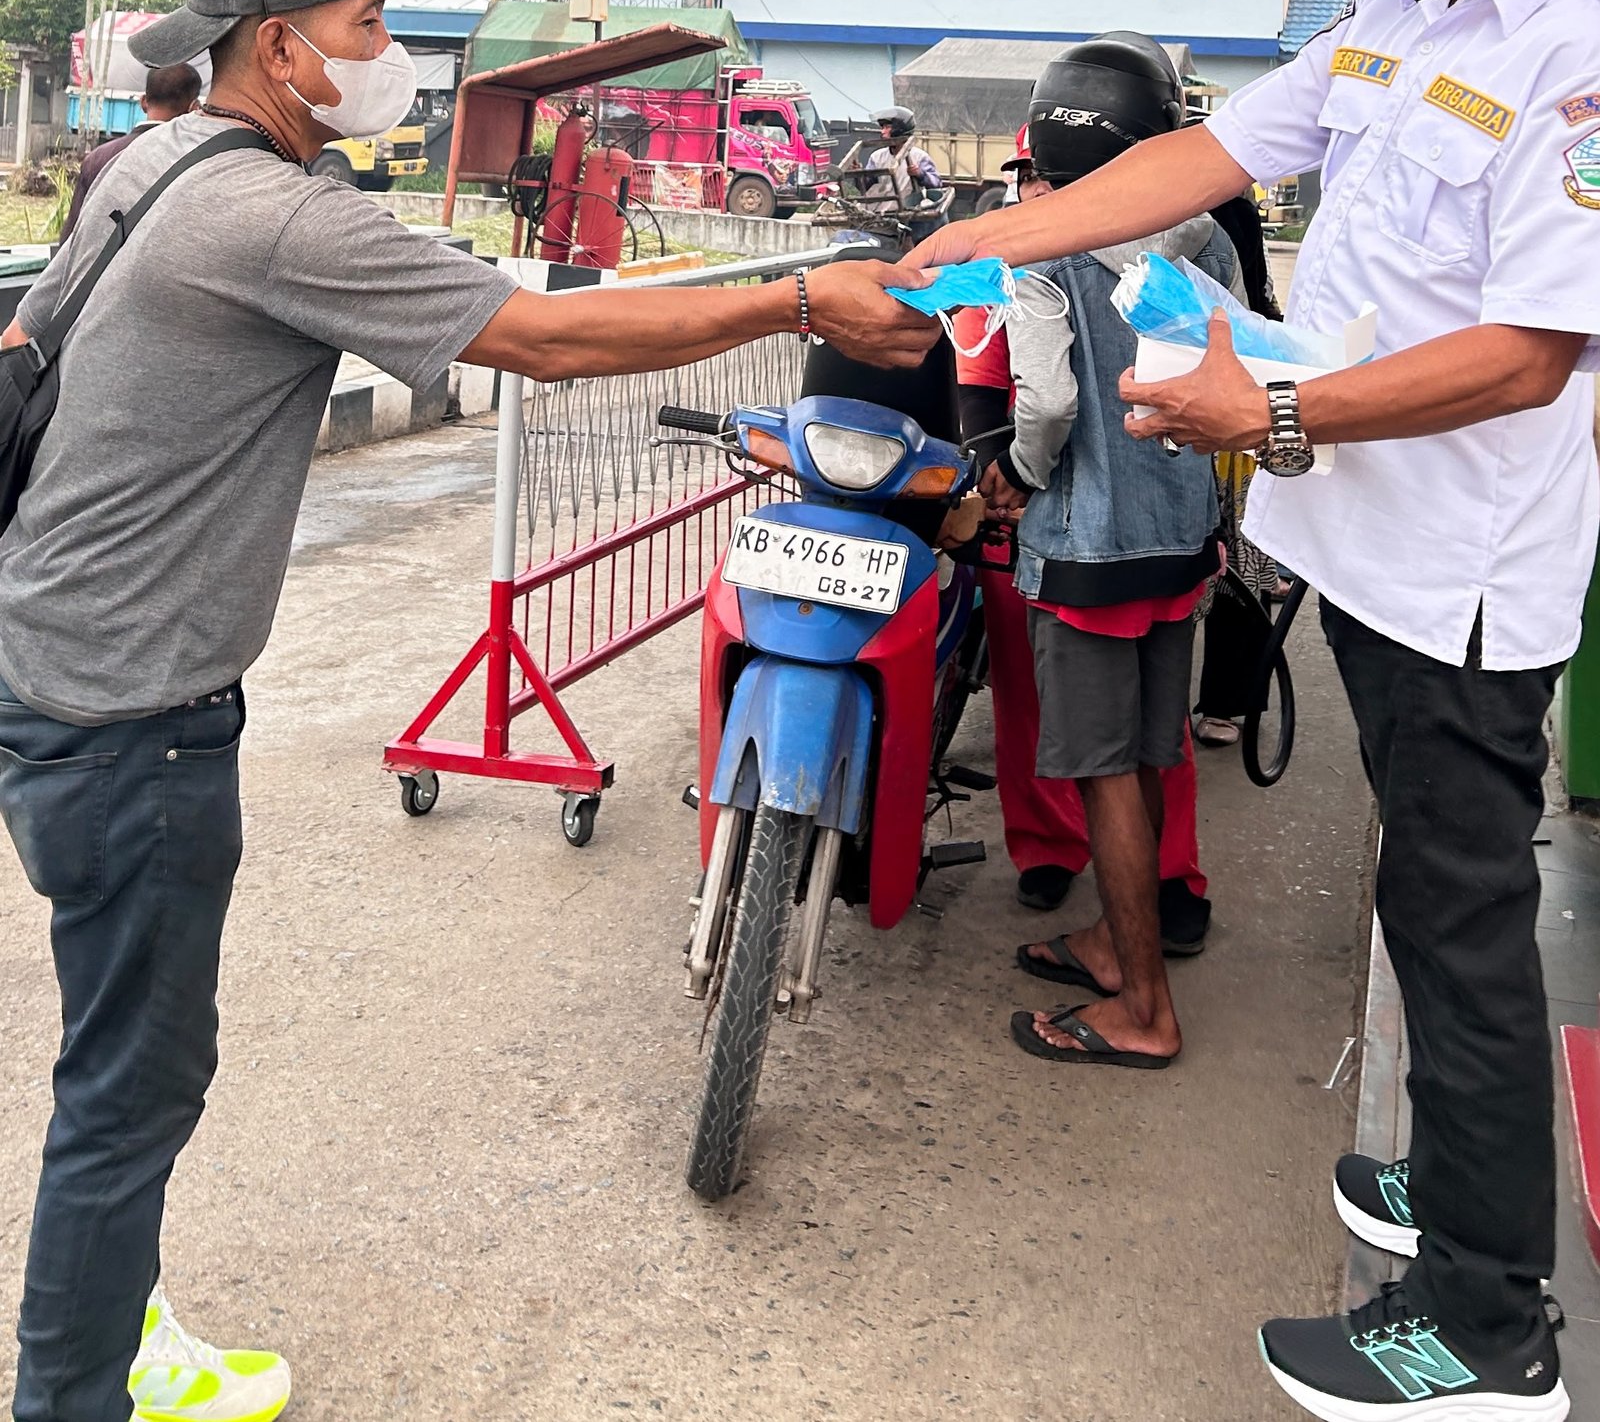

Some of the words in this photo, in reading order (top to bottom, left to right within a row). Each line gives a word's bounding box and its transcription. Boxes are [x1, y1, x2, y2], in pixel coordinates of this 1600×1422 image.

[1376, 60, 1391, 78] P
[1431, 80, 1506, 132] ORGANDA
[736, 524, 770, 553] KB
[782, 534, 846, 566] 4966
[867, 548, 899, 576] HP
